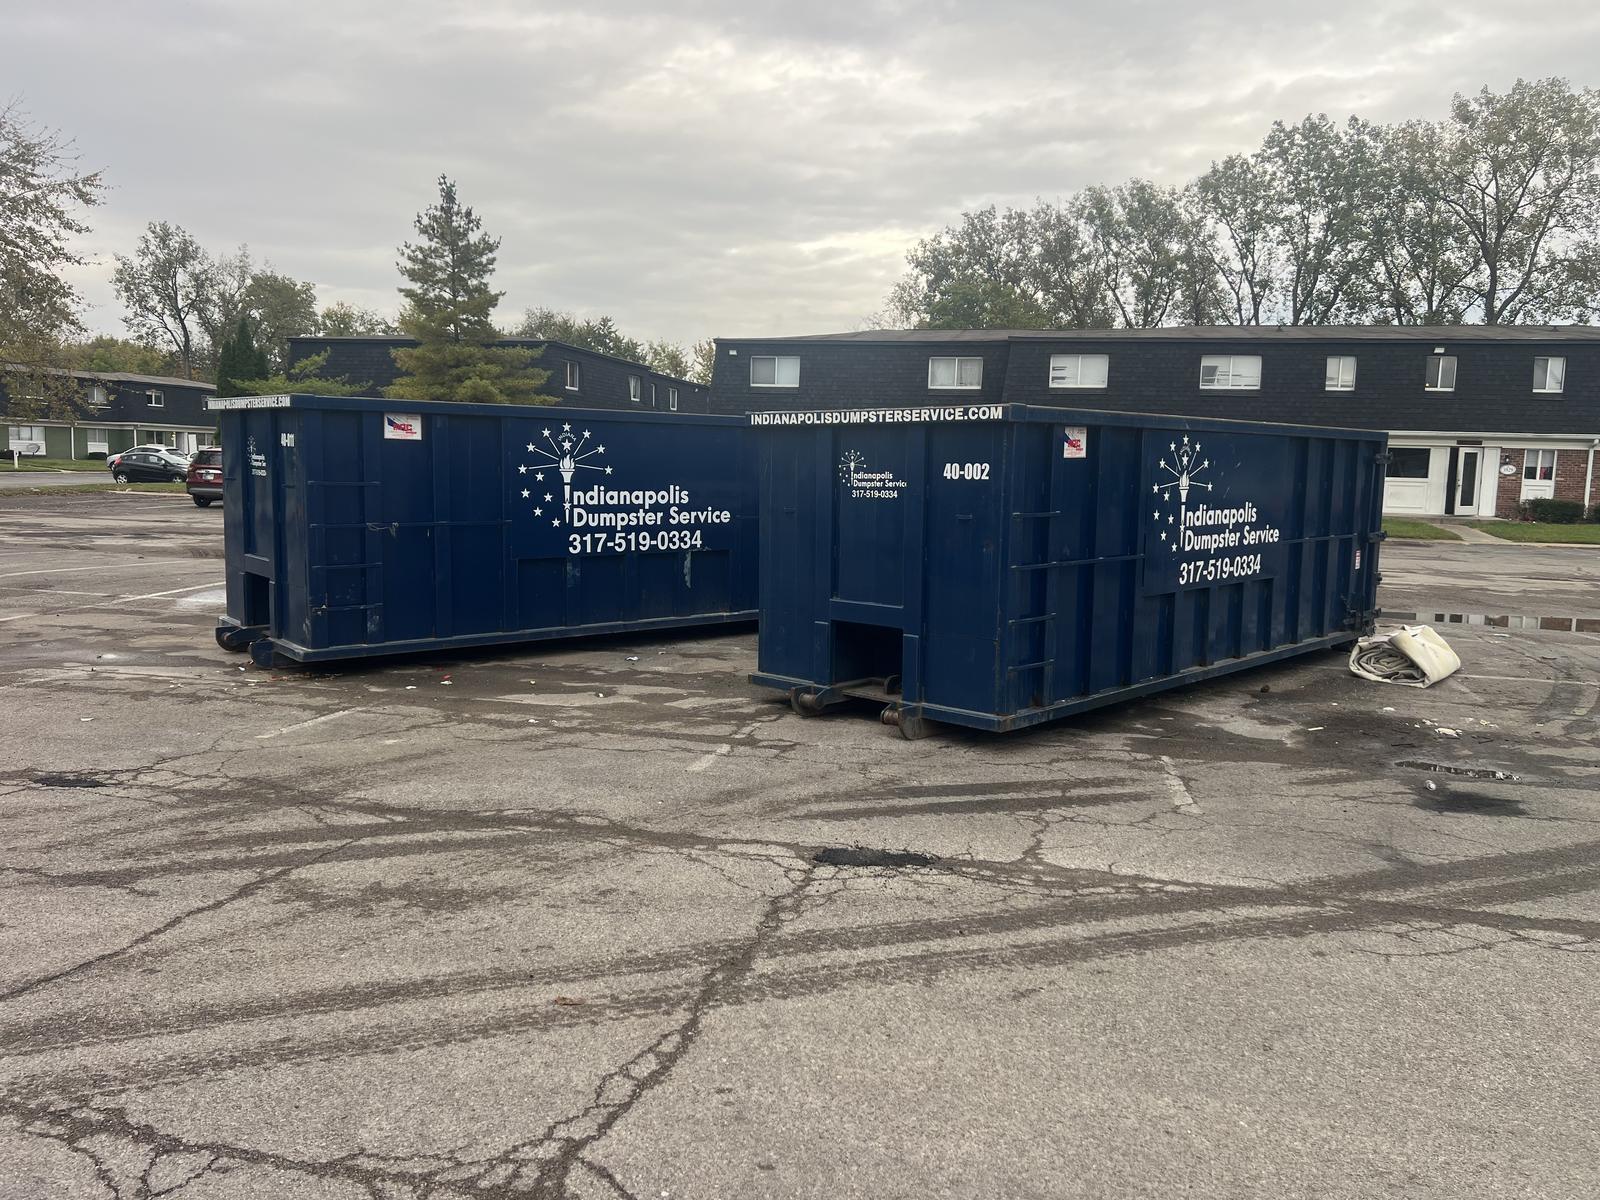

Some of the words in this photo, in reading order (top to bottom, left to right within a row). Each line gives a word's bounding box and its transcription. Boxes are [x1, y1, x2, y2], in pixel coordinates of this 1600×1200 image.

[751, 406, 1003, 425] INDIANAPOLISDUMPSTERSERVICE.COM
[851, 471, 893, 481] Indianapolis
[943, 463, 990, 480] 40-002
[851, 489, 898, 498] 317-519-0334
[853, 479, 884, 489] Dumpster
[564, 485, 689, 509] Indianapolis
[573, 507, 663, 530] Dumpster
[669, 506, 731, 525] Service
[1181, 501, 1257, 529] Indianapolis
[568, 530, 703, 554] 317-519-0334
[1184, 529, 1241, 554] Dumpster
[1243, 525, 1280, 545] Service
[1179, 554, 1261, 585] 317-519-0334
